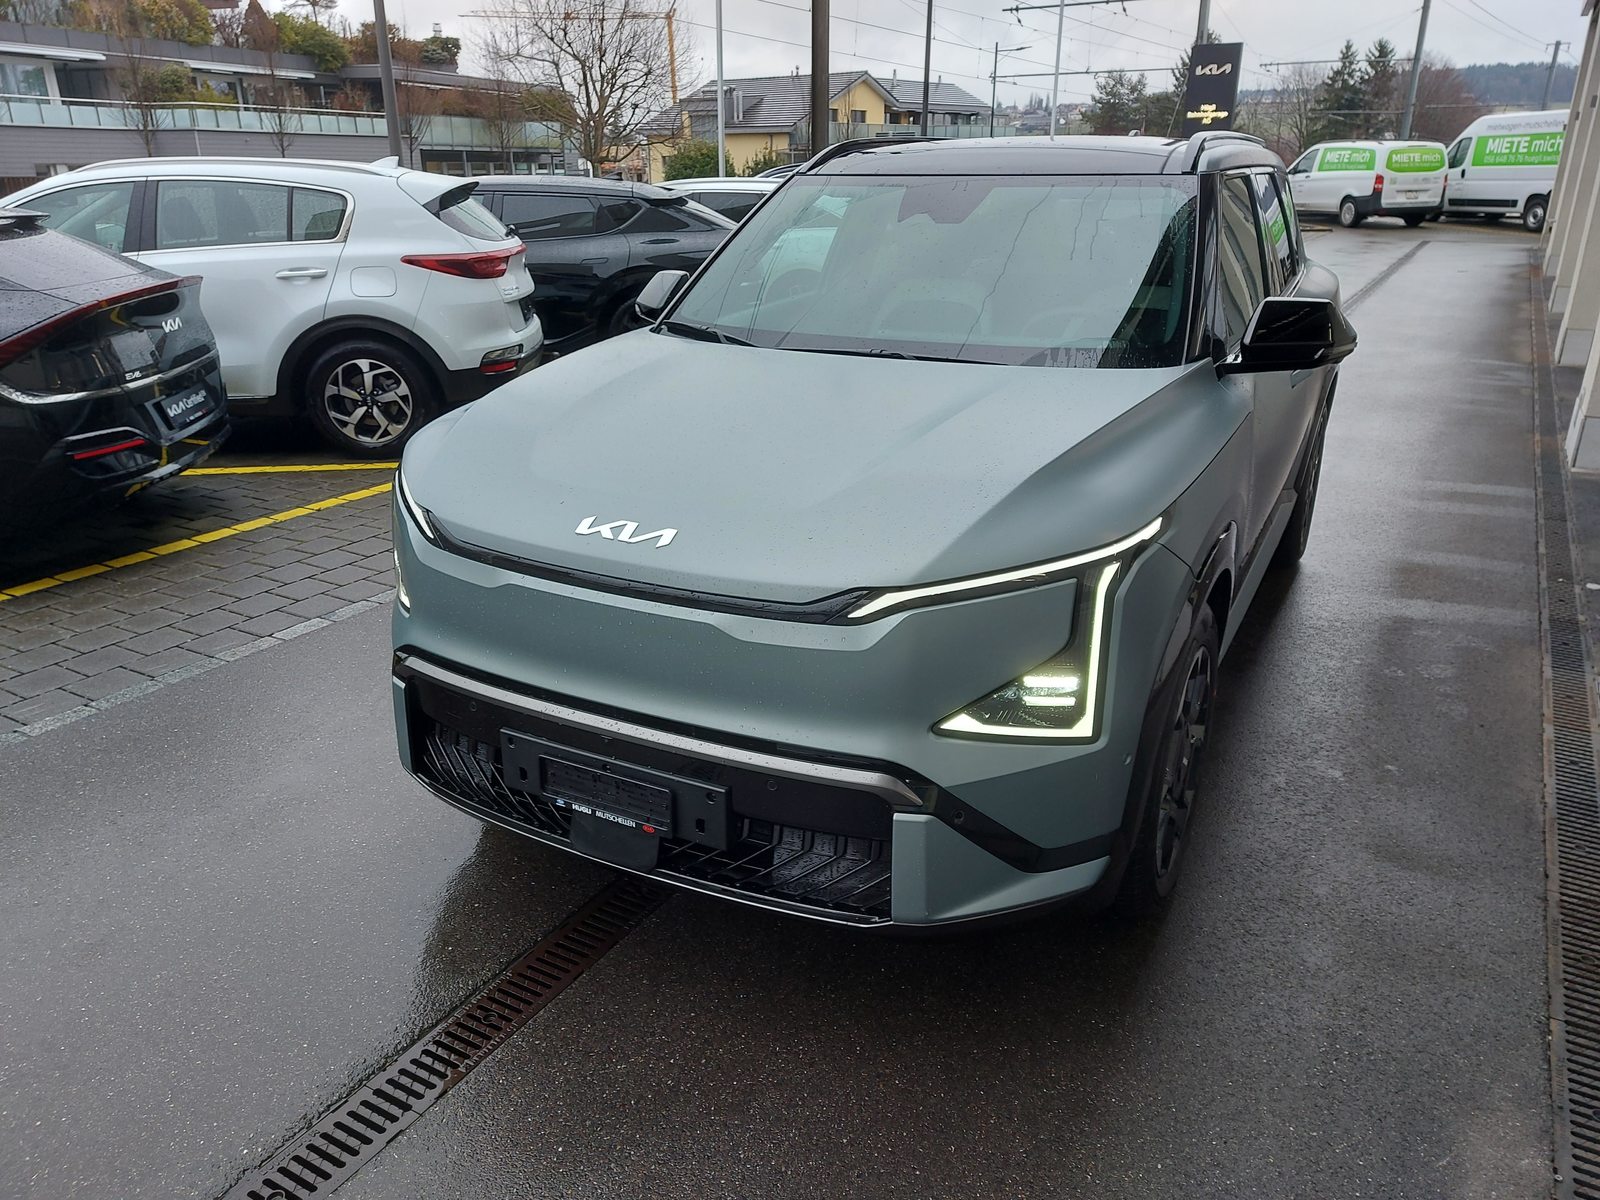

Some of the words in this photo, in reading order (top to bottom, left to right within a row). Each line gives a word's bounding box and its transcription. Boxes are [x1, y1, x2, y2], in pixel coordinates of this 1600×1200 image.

[1195, 63, 1232, 76] KIA
[1486, 136, 1531, 154] MIETE
[1531, 136, 1563, 153] mich
[1325, 150, 1352, 162] MIETE
[1351, 151, 1371, 162] mich
[1392, 153, 1421, 162] MIETE
[1422, 152, 1441, 162] mich
[162, 317, 183, 333] KIA
[125, 371, 142, 381] EV6
[167, 401, 186, 418] KIA
[575, 515, 678, 549] KIA
[595, 810, 636, 828] MUTSCHELLEN
